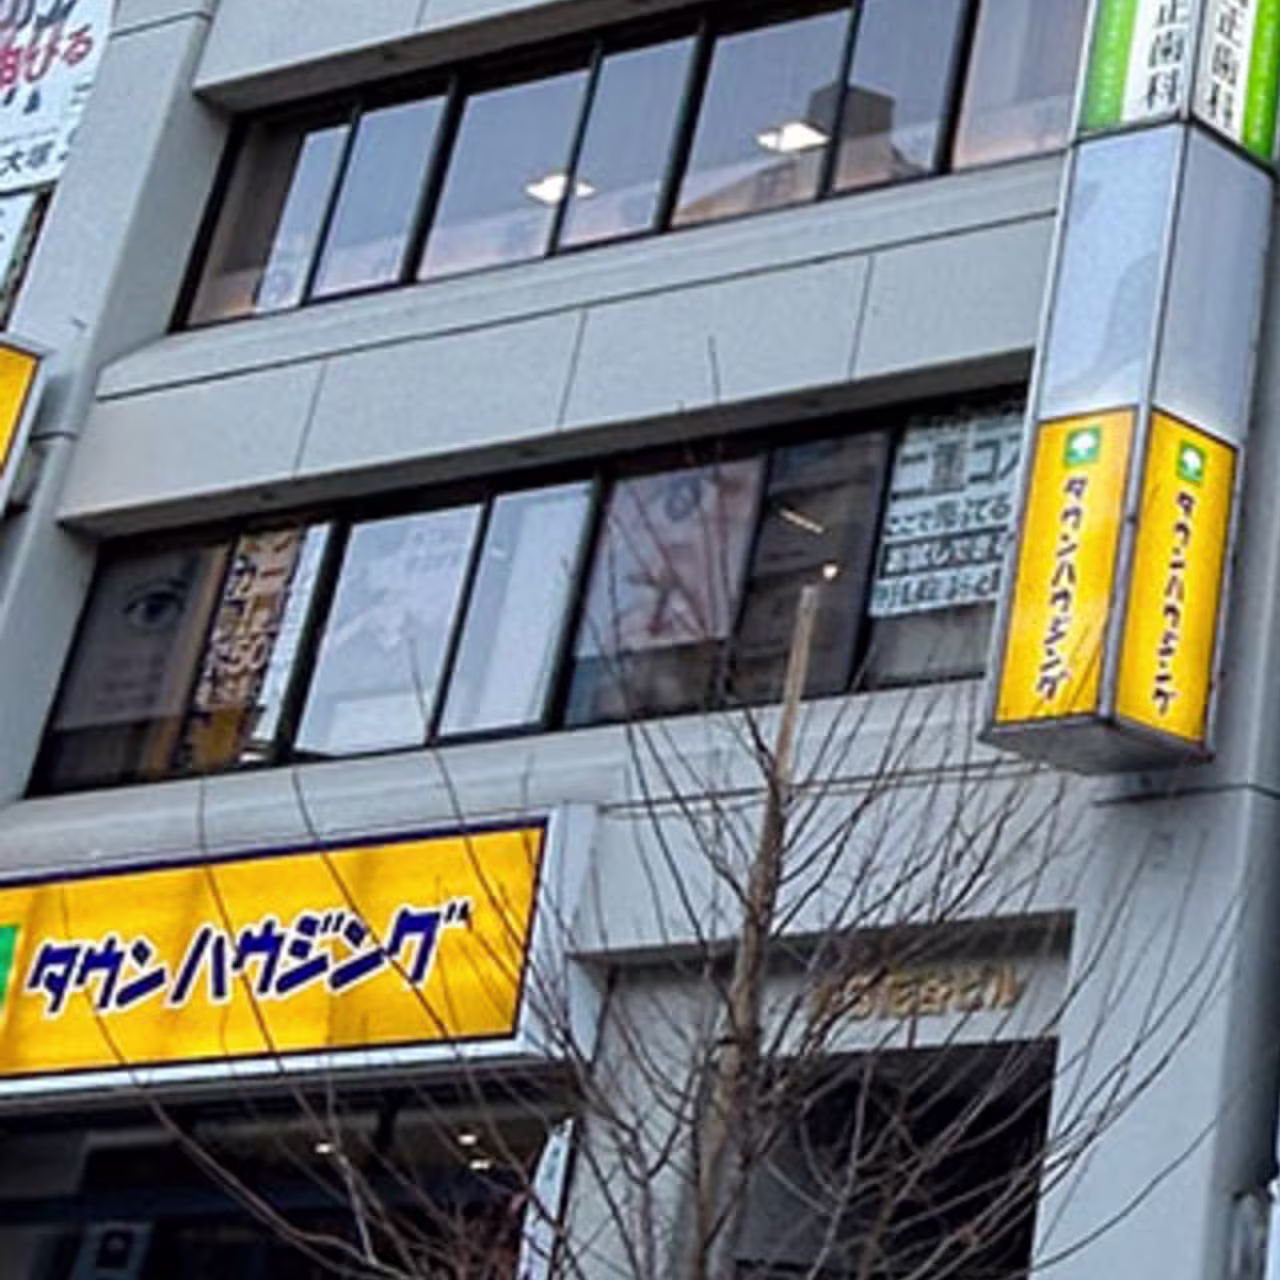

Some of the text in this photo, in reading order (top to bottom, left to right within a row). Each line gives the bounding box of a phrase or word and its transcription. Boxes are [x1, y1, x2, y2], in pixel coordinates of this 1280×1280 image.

[1037, 477, 1088, 700] タウンハウジング
[1151, 492, 1195, 715] タウンハウジング
[28, 901, 470, 1013] タウンハウジング
